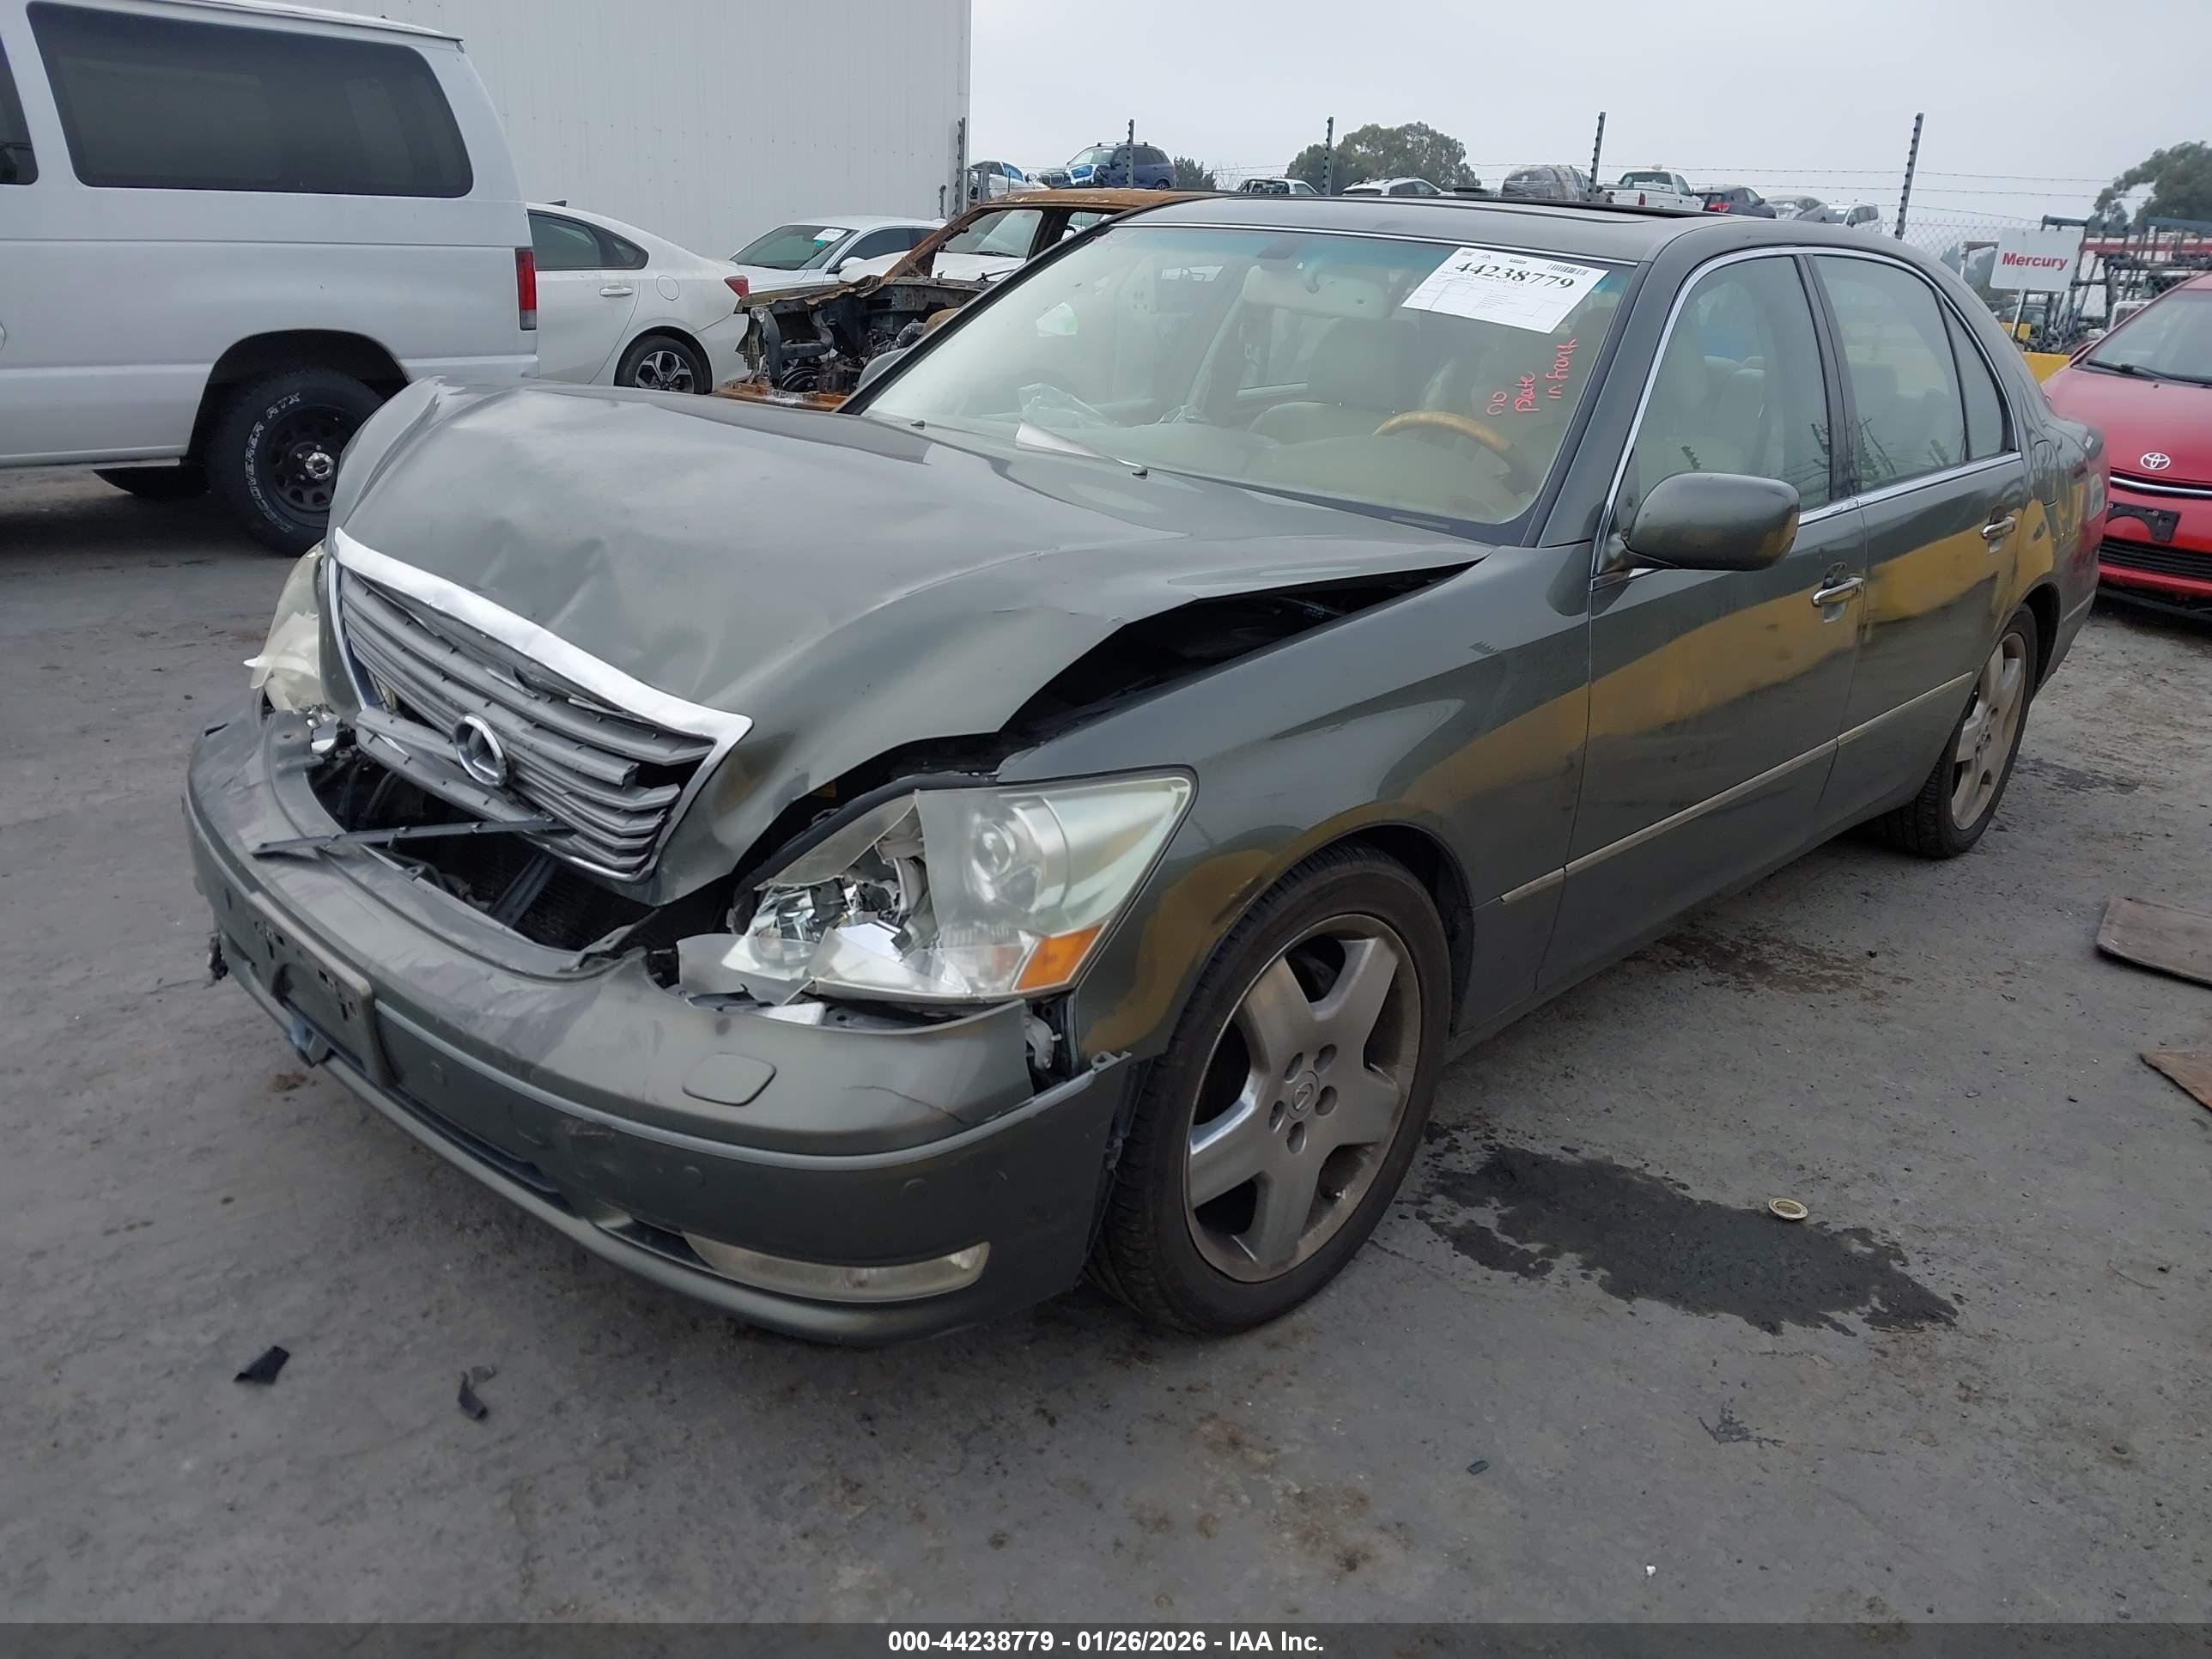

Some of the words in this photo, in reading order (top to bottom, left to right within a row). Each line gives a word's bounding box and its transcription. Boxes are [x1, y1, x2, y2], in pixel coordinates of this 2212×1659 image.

[1455, 261, 1576, 289] 44238779
[2002, 252, 2069, 271] Mercury
[265, 392, 301, 420] RTX
[244, 421, 294, 533] DISCOVERER
